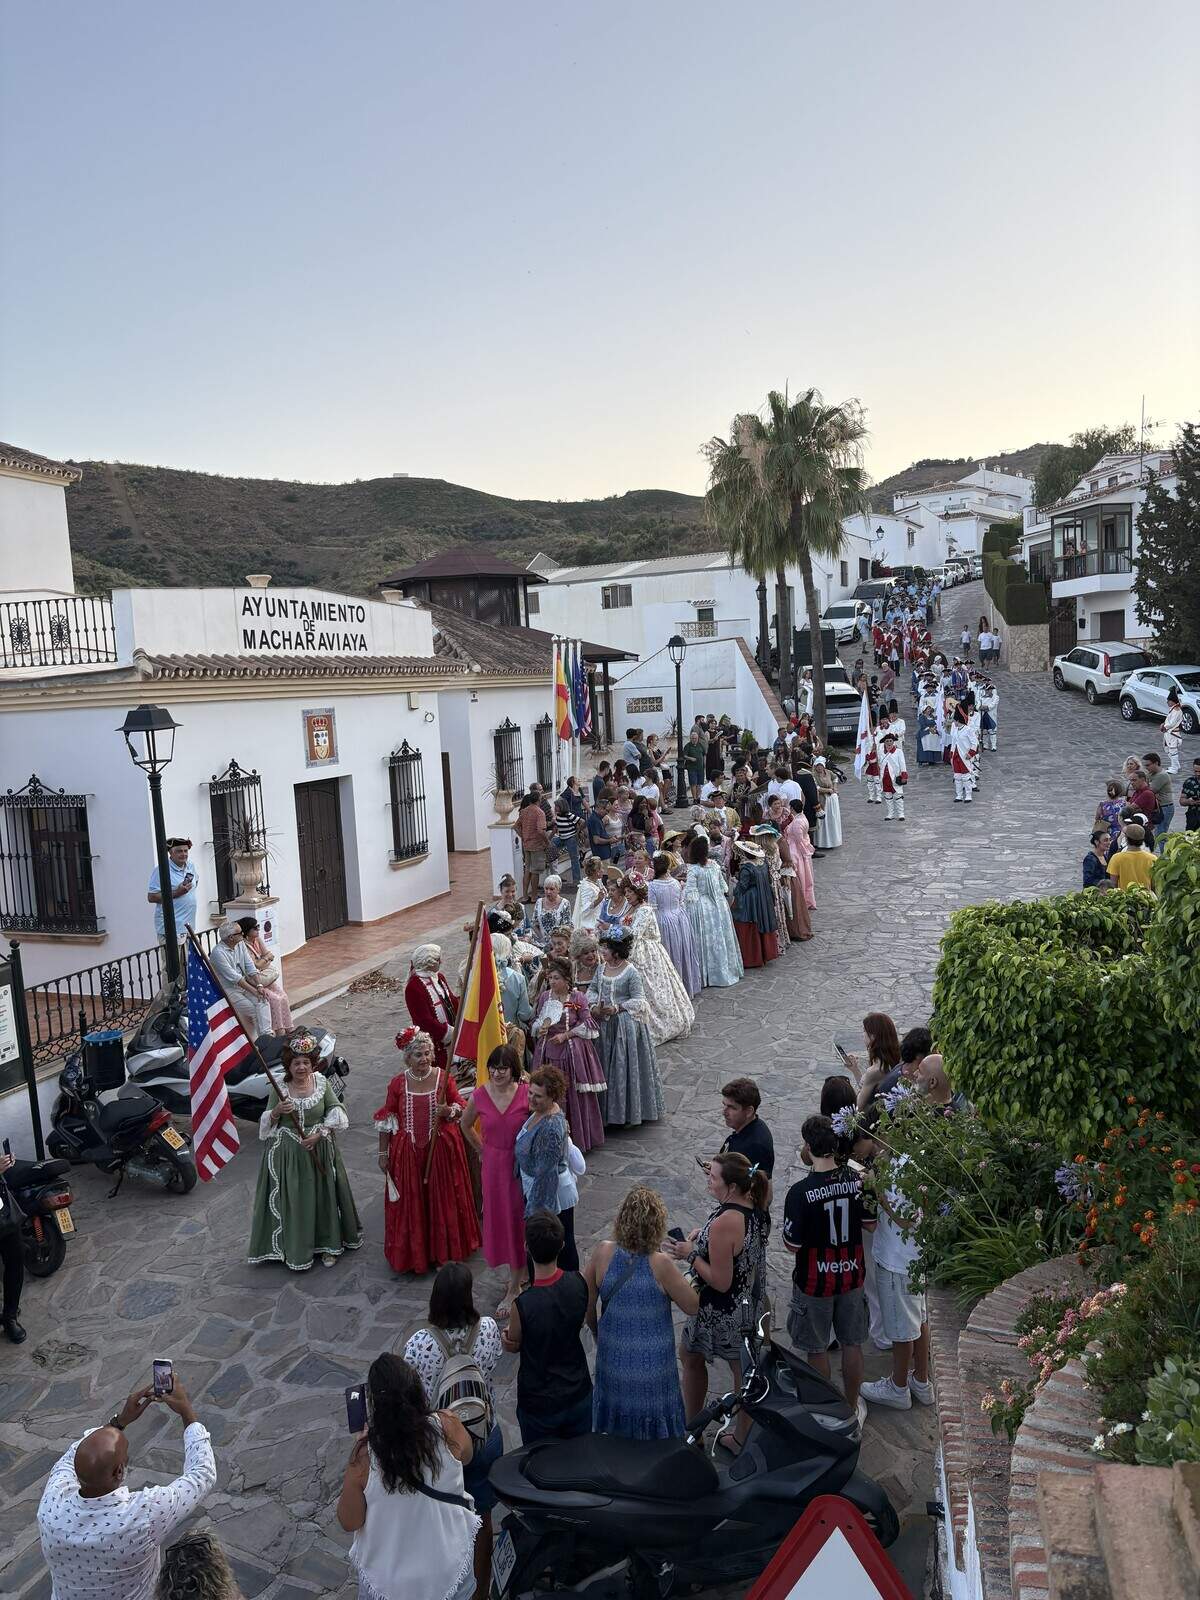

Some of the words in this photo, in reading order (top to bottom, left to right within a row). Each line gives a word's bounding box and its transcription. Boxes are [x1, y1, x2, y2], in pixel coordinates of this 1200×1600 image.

[242, 596, 366, 623] AYUNTAMIENTO
[303, 620, 316, 632] DE
[243, 629, 368, 652] MACHARAVIAYA
[823, 1197, 849, 1246] 11
[817, 1258, 859, 1274] wefox
